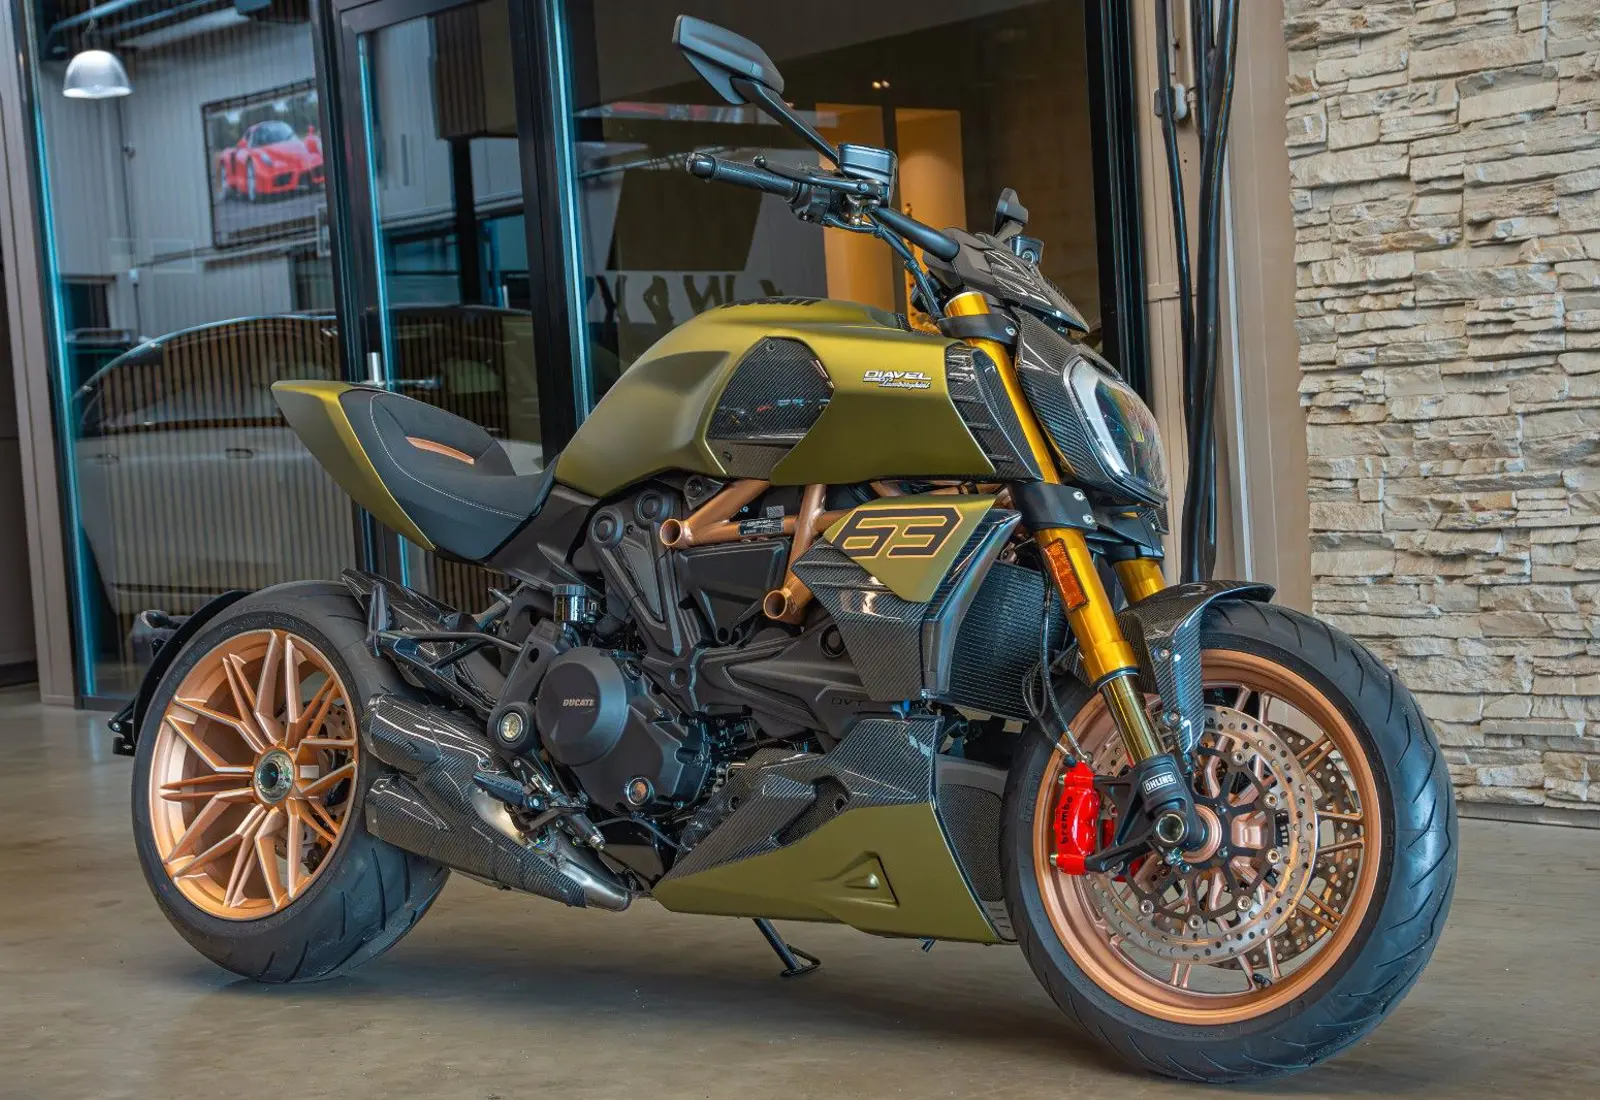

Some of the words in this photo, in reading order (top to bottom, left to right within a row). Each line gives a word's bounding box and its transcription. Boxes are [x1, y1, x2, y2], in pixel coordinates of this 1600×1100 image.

[864, 370, 931, 380] DIAVEL
[830, 505, 963, 558] 63
[562, 698, 595, 707] DUCATI
[1060, 796, 1073, 844] brembo
